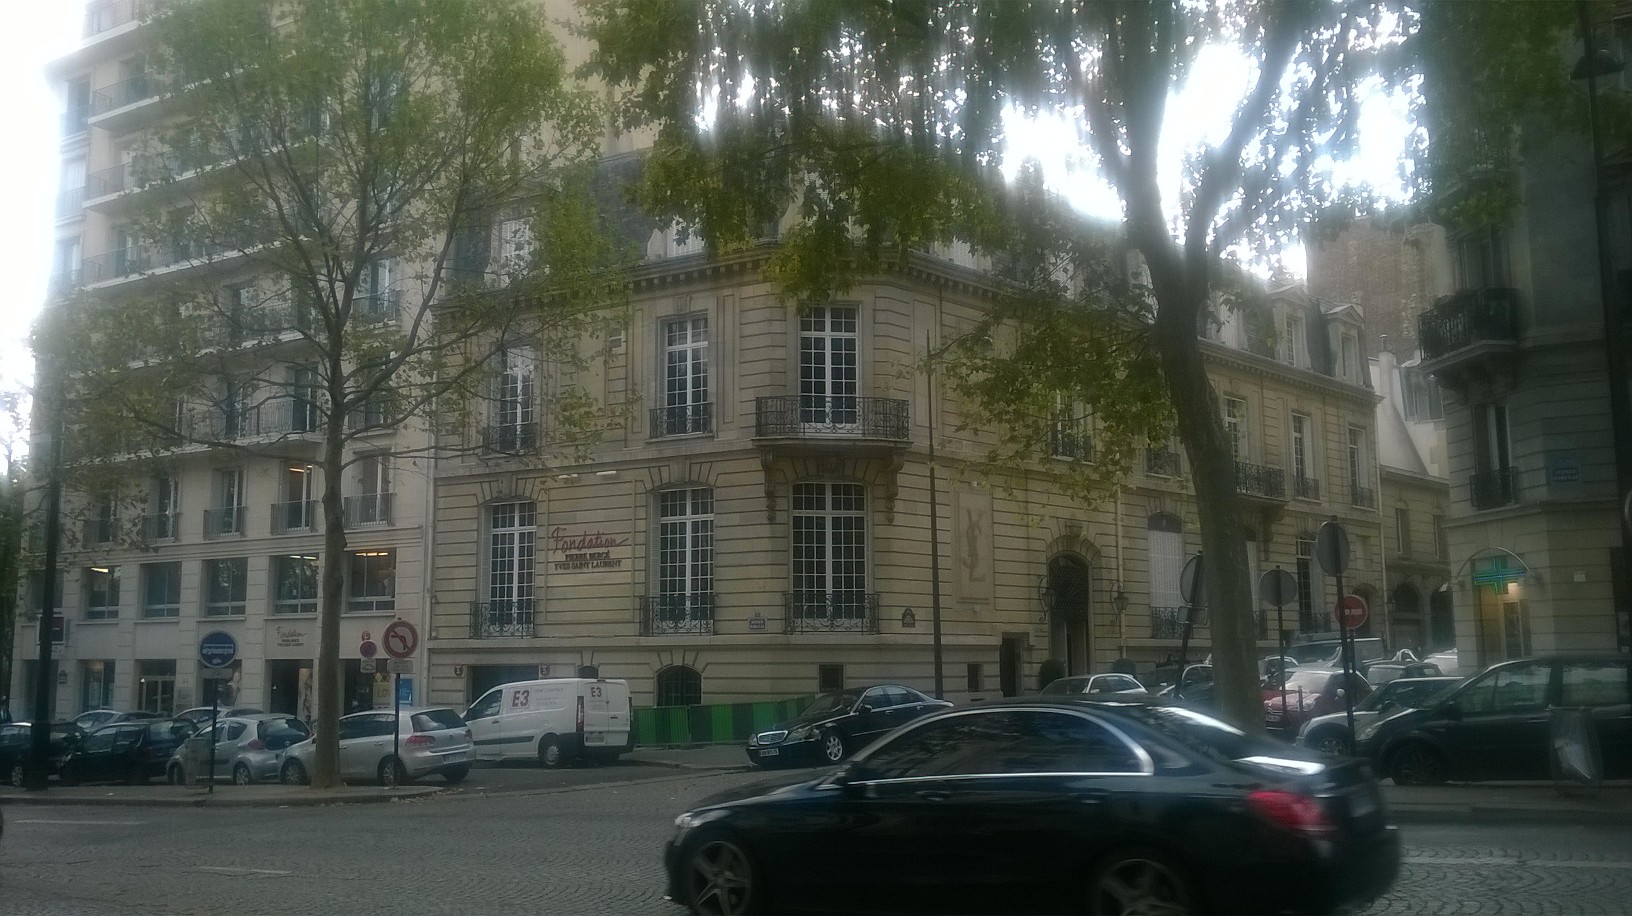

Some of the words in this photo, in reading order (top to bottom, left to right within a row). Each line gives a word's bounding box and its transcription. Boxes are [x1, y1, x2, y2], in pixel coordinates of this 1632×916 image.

[551, 527, 629, 554] Fondation
[554, 562, 571, 571] YVES
[571, 561, 590, 570] SAINT
[591, 560, 622, 569] LAURENT
[512, 689, 530, 708] E3
[591, 686, 602, 698] E3
